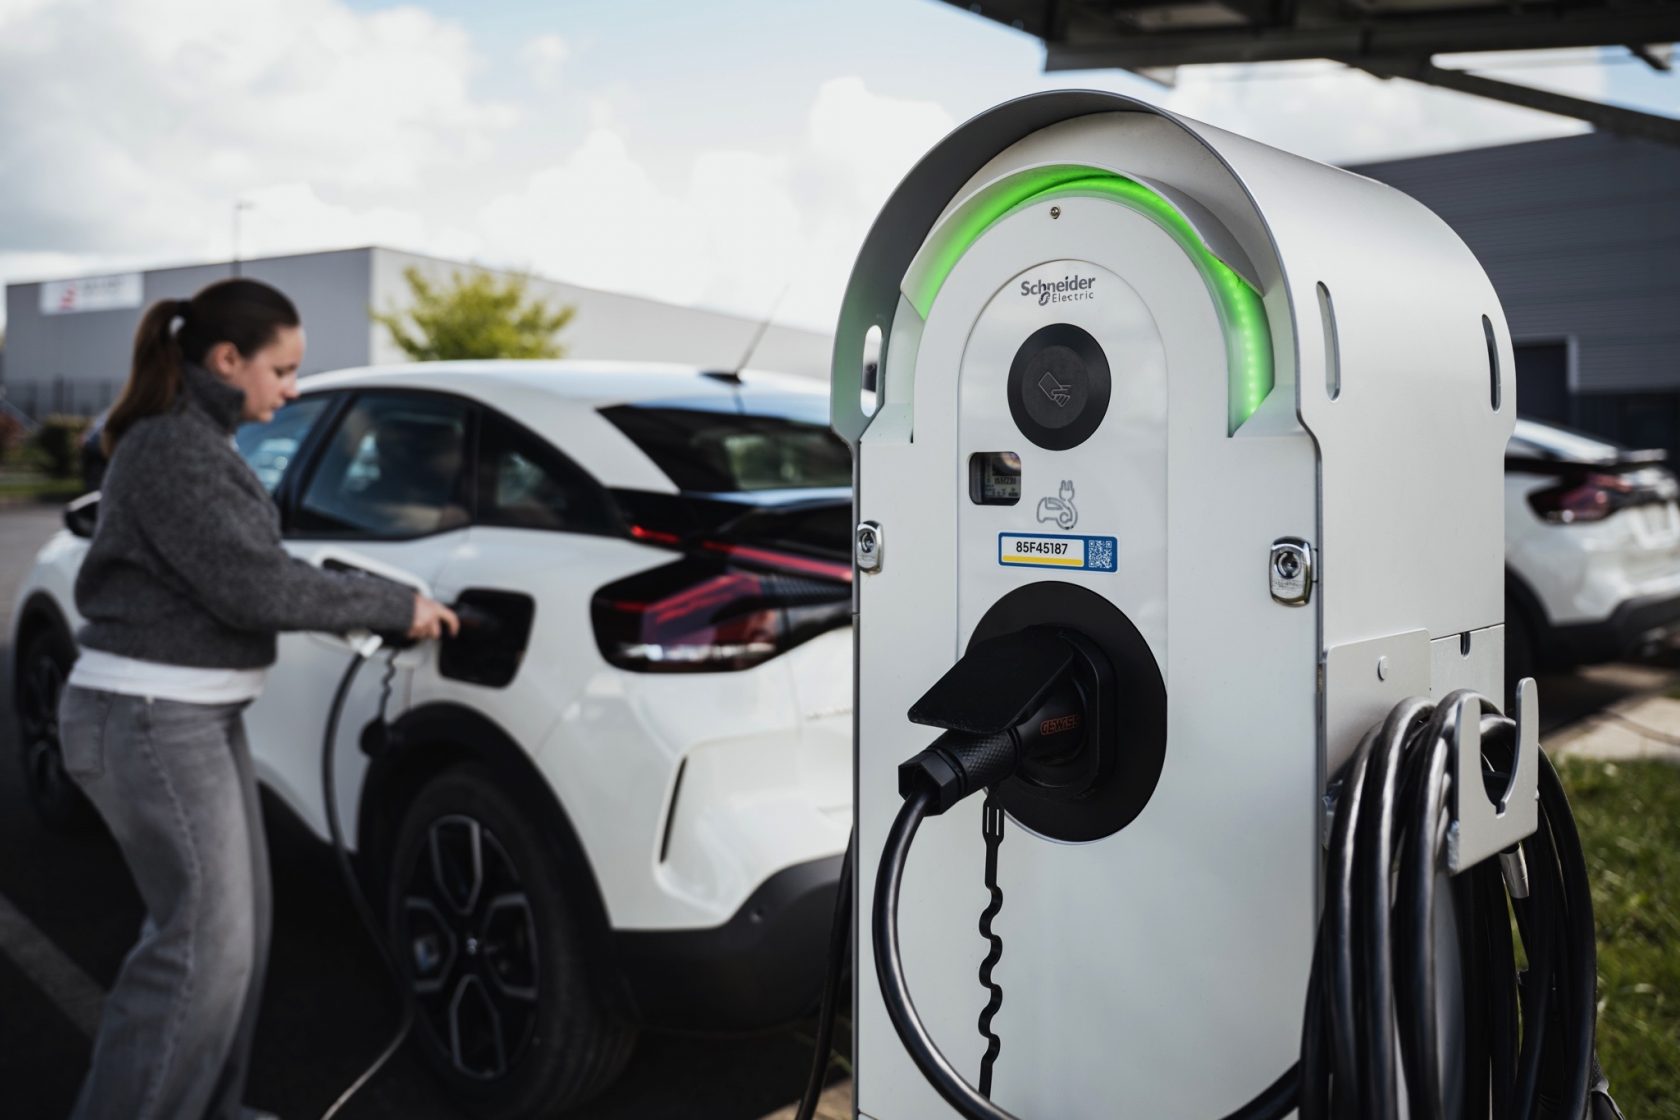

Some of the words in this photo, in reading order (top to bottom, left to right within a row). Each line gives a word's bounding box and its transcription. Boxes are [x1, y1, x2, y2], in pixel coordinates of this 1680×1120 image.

[1021, 275, 1096, 296] Schneider
[1052, 291, 1094, 303] Electric
[1016, 541, 1068, 555] 85F45187
